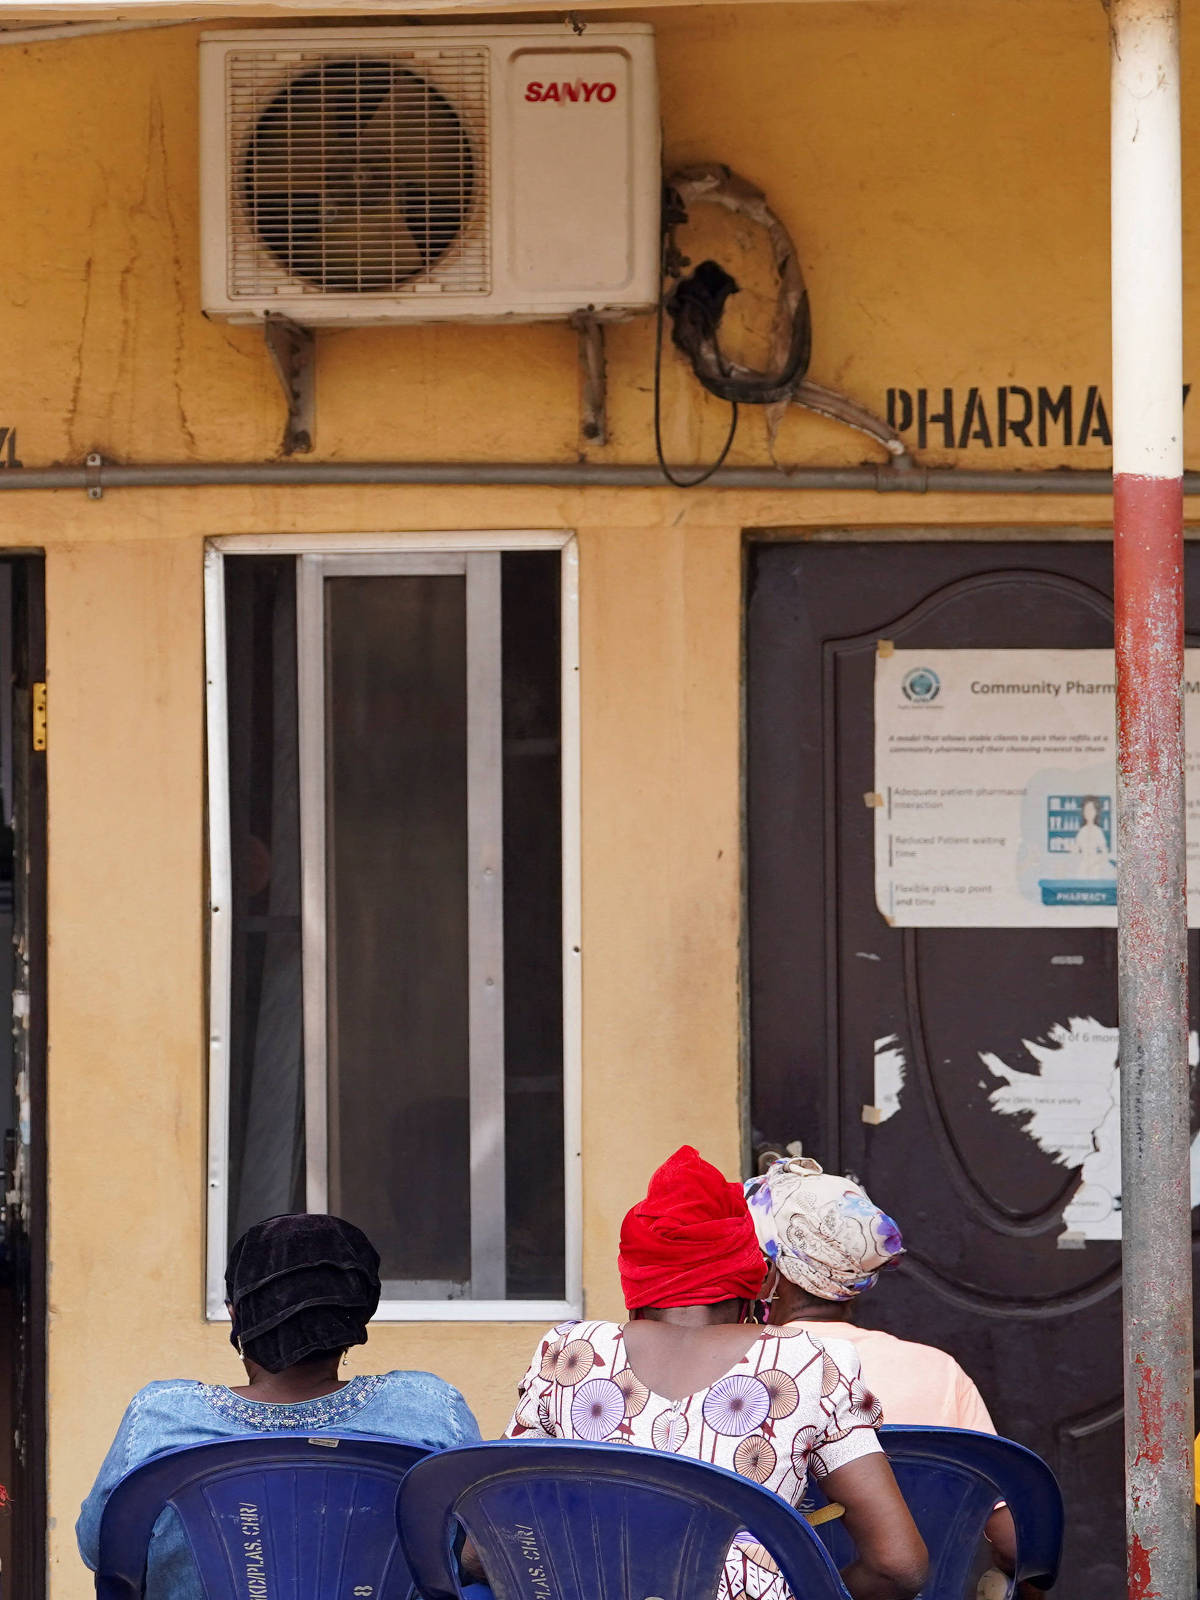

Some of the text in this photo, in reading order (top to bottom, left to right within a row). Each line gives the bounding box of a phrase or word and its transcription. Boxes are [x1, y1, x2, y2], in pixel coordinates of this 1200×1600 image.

[524, 79, 617, 105] SANYO
[886, 384, 1192, 448] PHARMA
[970, 681, 1061, 696] Community
[1065, 681, 1116, 694] Pharm
[894, 788, 938, 797] Adequate
[895, 835, 935, 845] Reduced
[895, 884, 929, 893] Flexible
[1057, 892, 1106, 901] PHARMACY
[243, 1539, 268, 1600] KD/PLAS.
